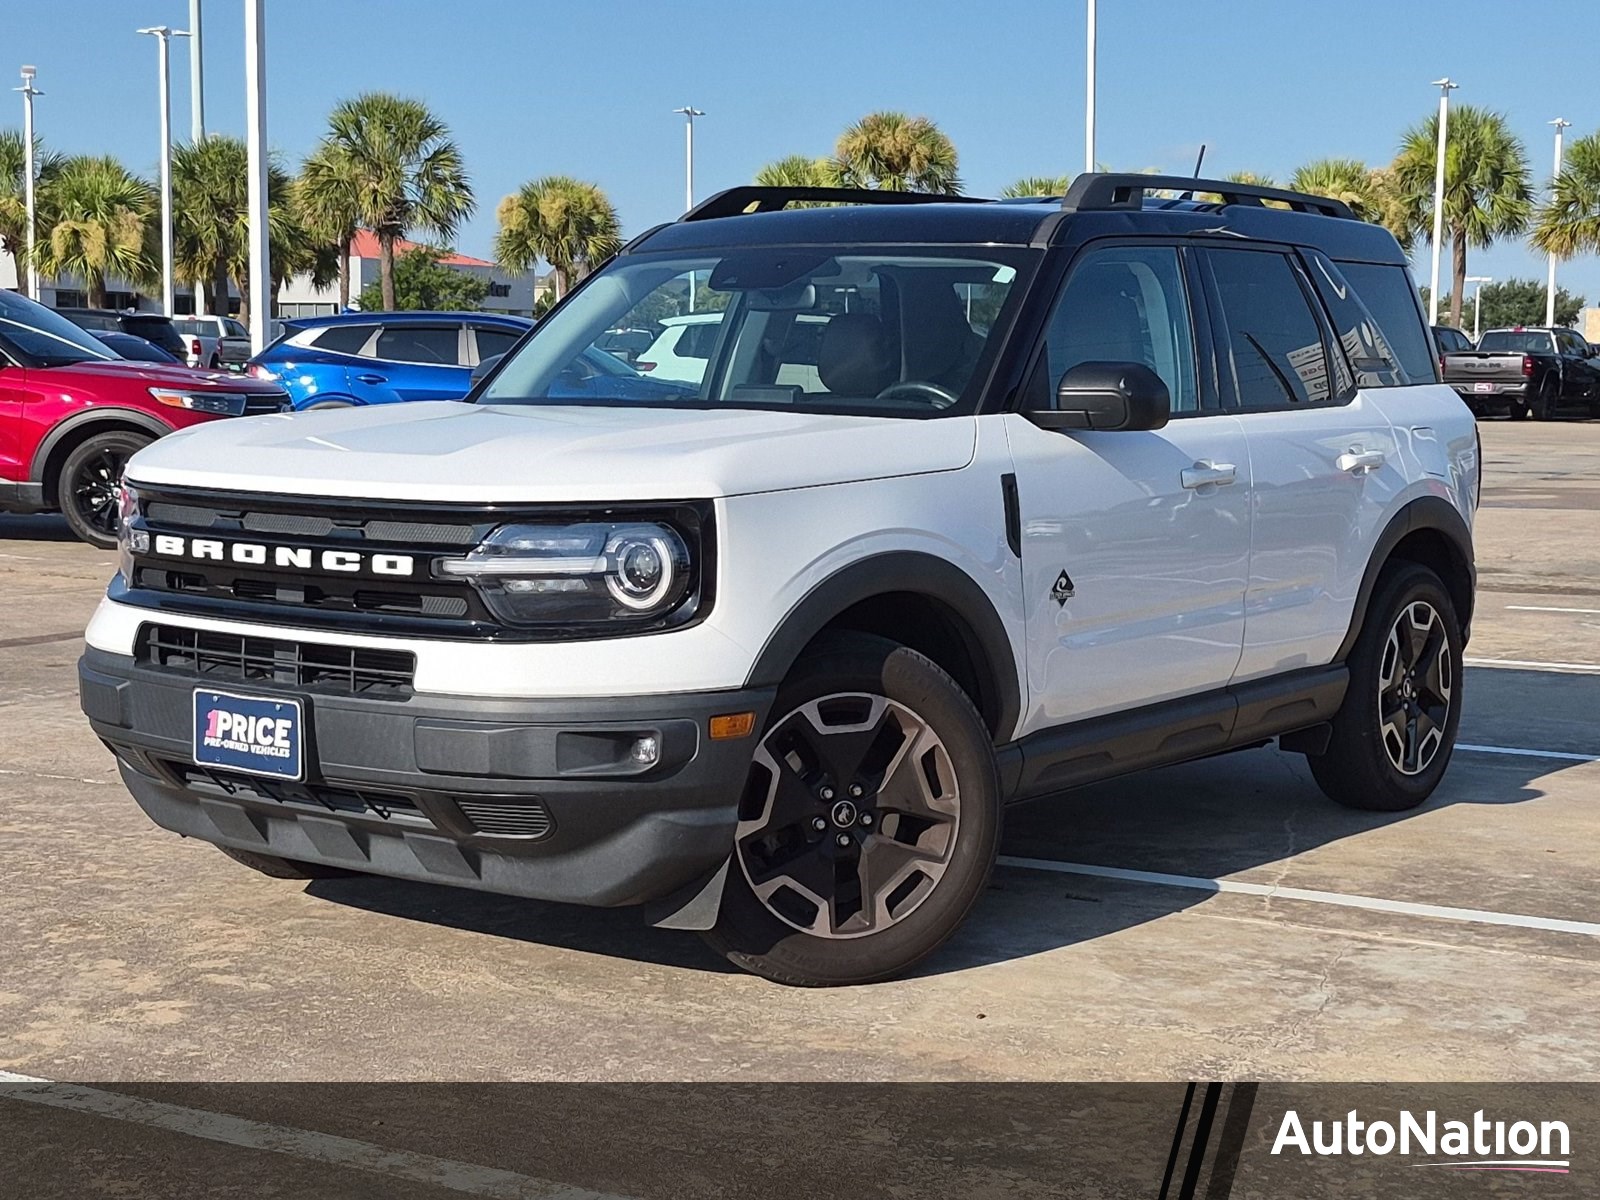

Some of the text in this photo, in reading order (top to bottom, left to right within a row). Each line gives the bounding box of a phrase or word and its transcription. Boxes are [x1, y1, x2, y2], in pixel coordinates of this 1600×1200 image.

[155, 535, 414, 576] BRONCO
[203, 736, 291, 758] PRE-OWNED VEHICLES
[205, 709, 292, 748] 1PRICE
